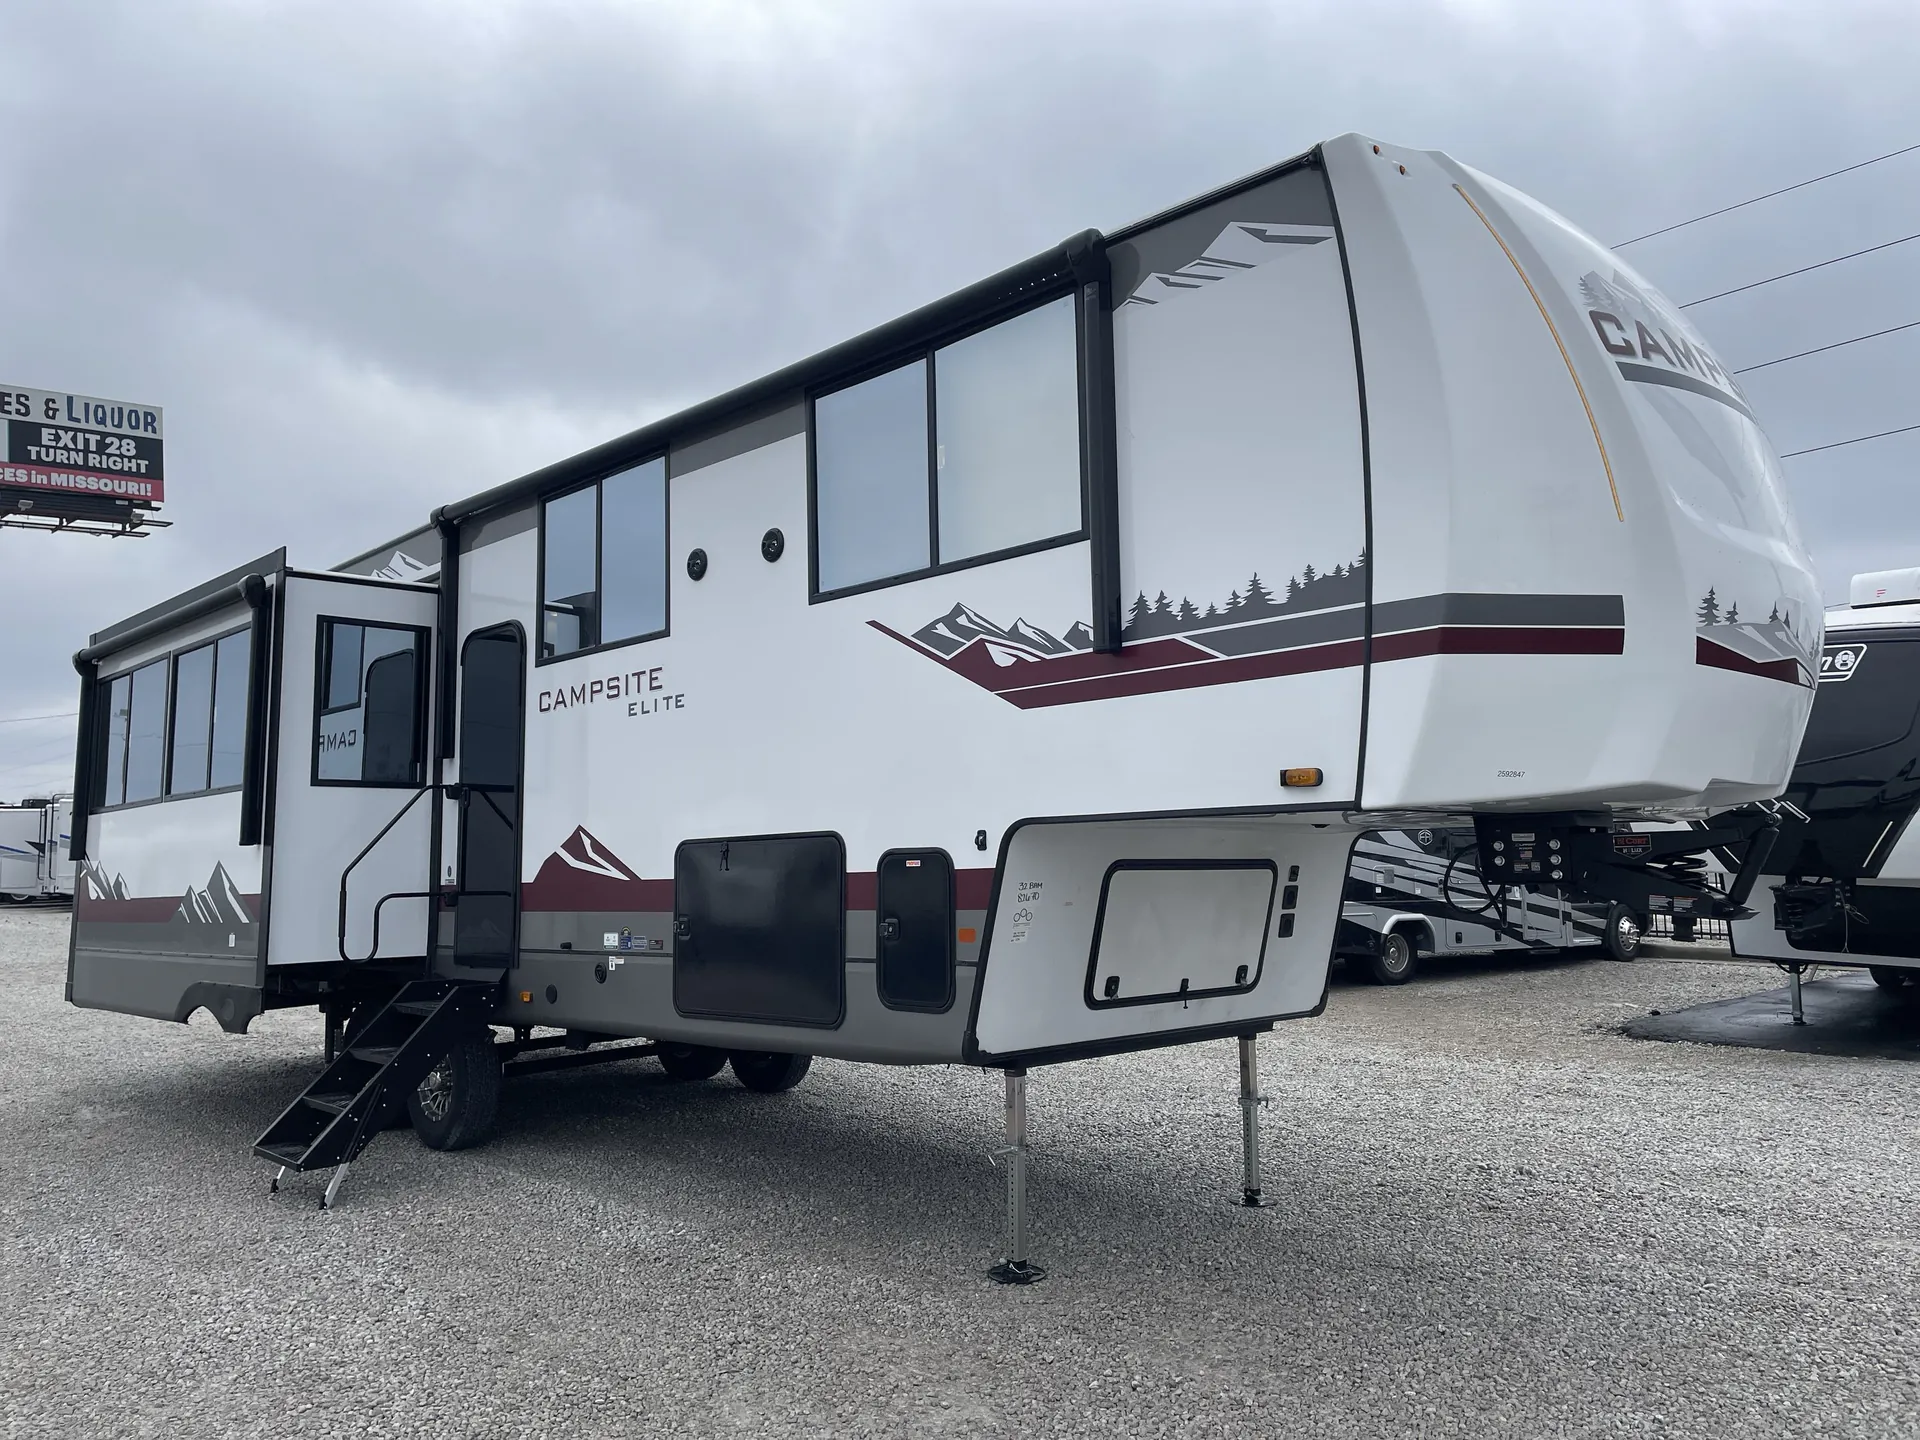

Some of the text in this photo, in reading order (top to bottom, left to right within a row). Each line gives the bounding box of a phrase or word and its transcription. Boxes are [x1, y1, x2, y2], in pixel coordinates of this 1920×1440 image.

[44, 398, 60, 420] &
[66, 395, 157, 435] LIQUOR
[41, 427, 137, 457] EXIT 28
[27, 445, 149, 474] TURN RIGHT
[31, 470, 48, 485] in
[50, 472, 152, 497] MISSOURI!
[539, 666, 663, 713] CAMPSITE
[628, 693, 685, 717] ELITE
